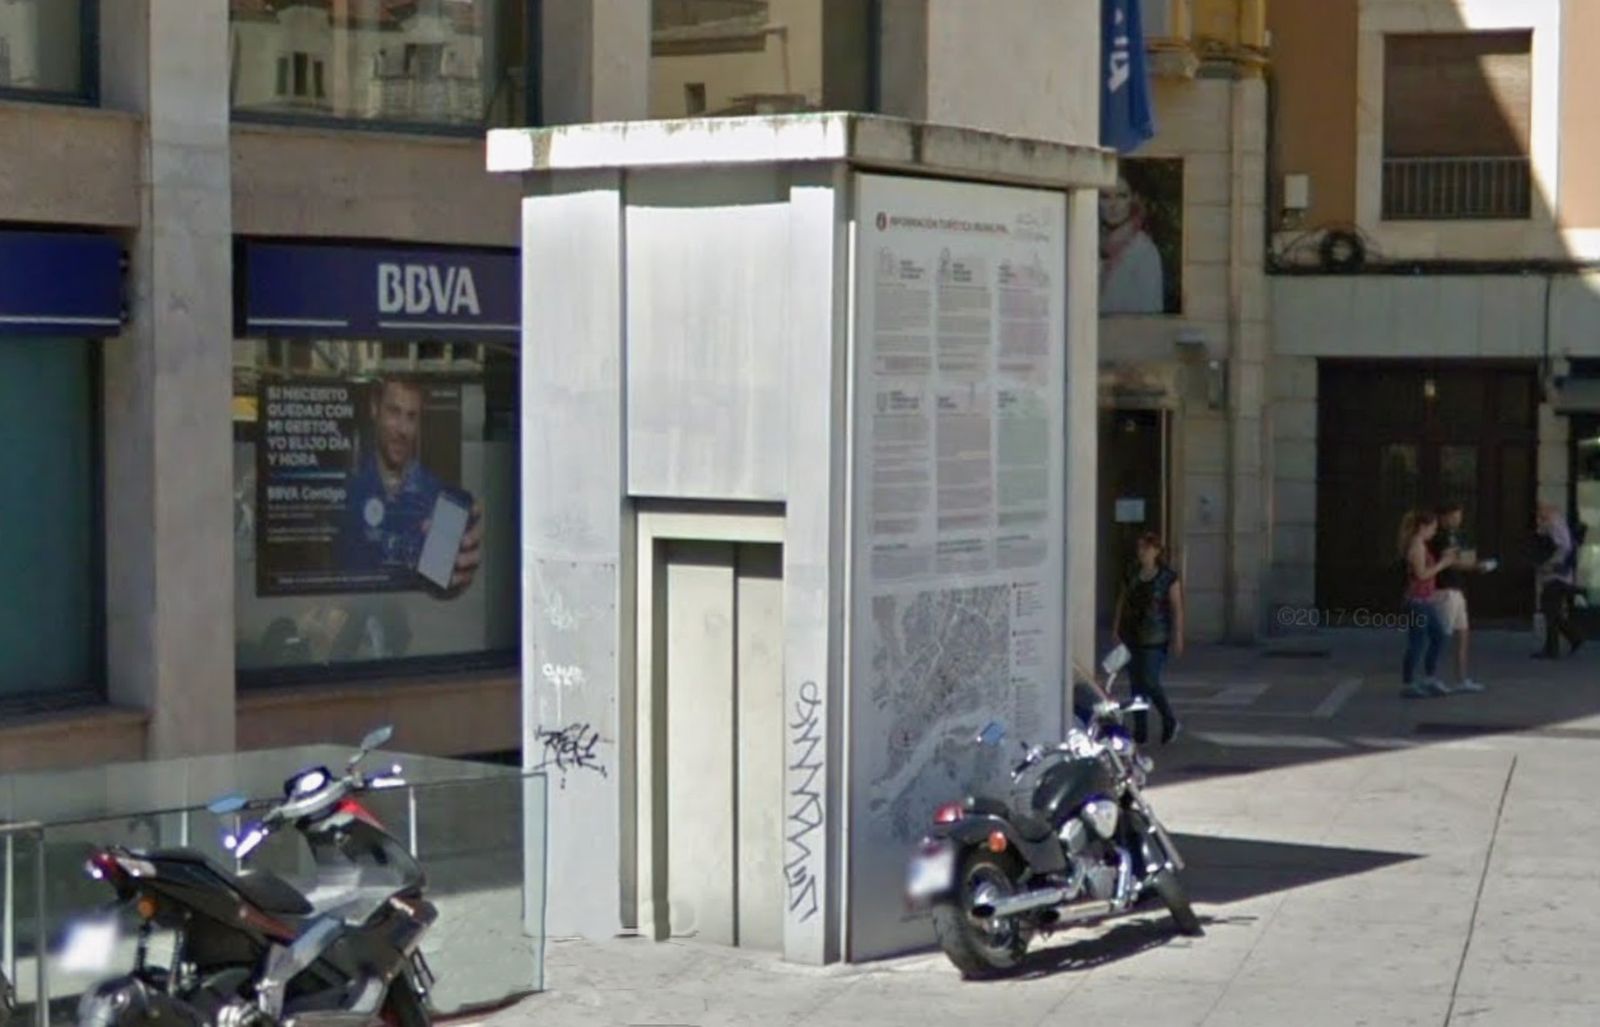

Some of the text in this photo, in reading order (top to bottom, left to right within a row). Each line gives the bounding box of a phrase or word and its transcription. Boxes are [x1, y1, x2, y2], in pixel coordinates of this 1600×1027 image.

[378, 263, 480, 315] BBVA
[267, 403, 354, 418] QUEDAR CON
[267, 436, 286, 450] YO
[267, 452, 319, 466] Y HORA
[267, 485, 347, 502] BBVA Contigo
